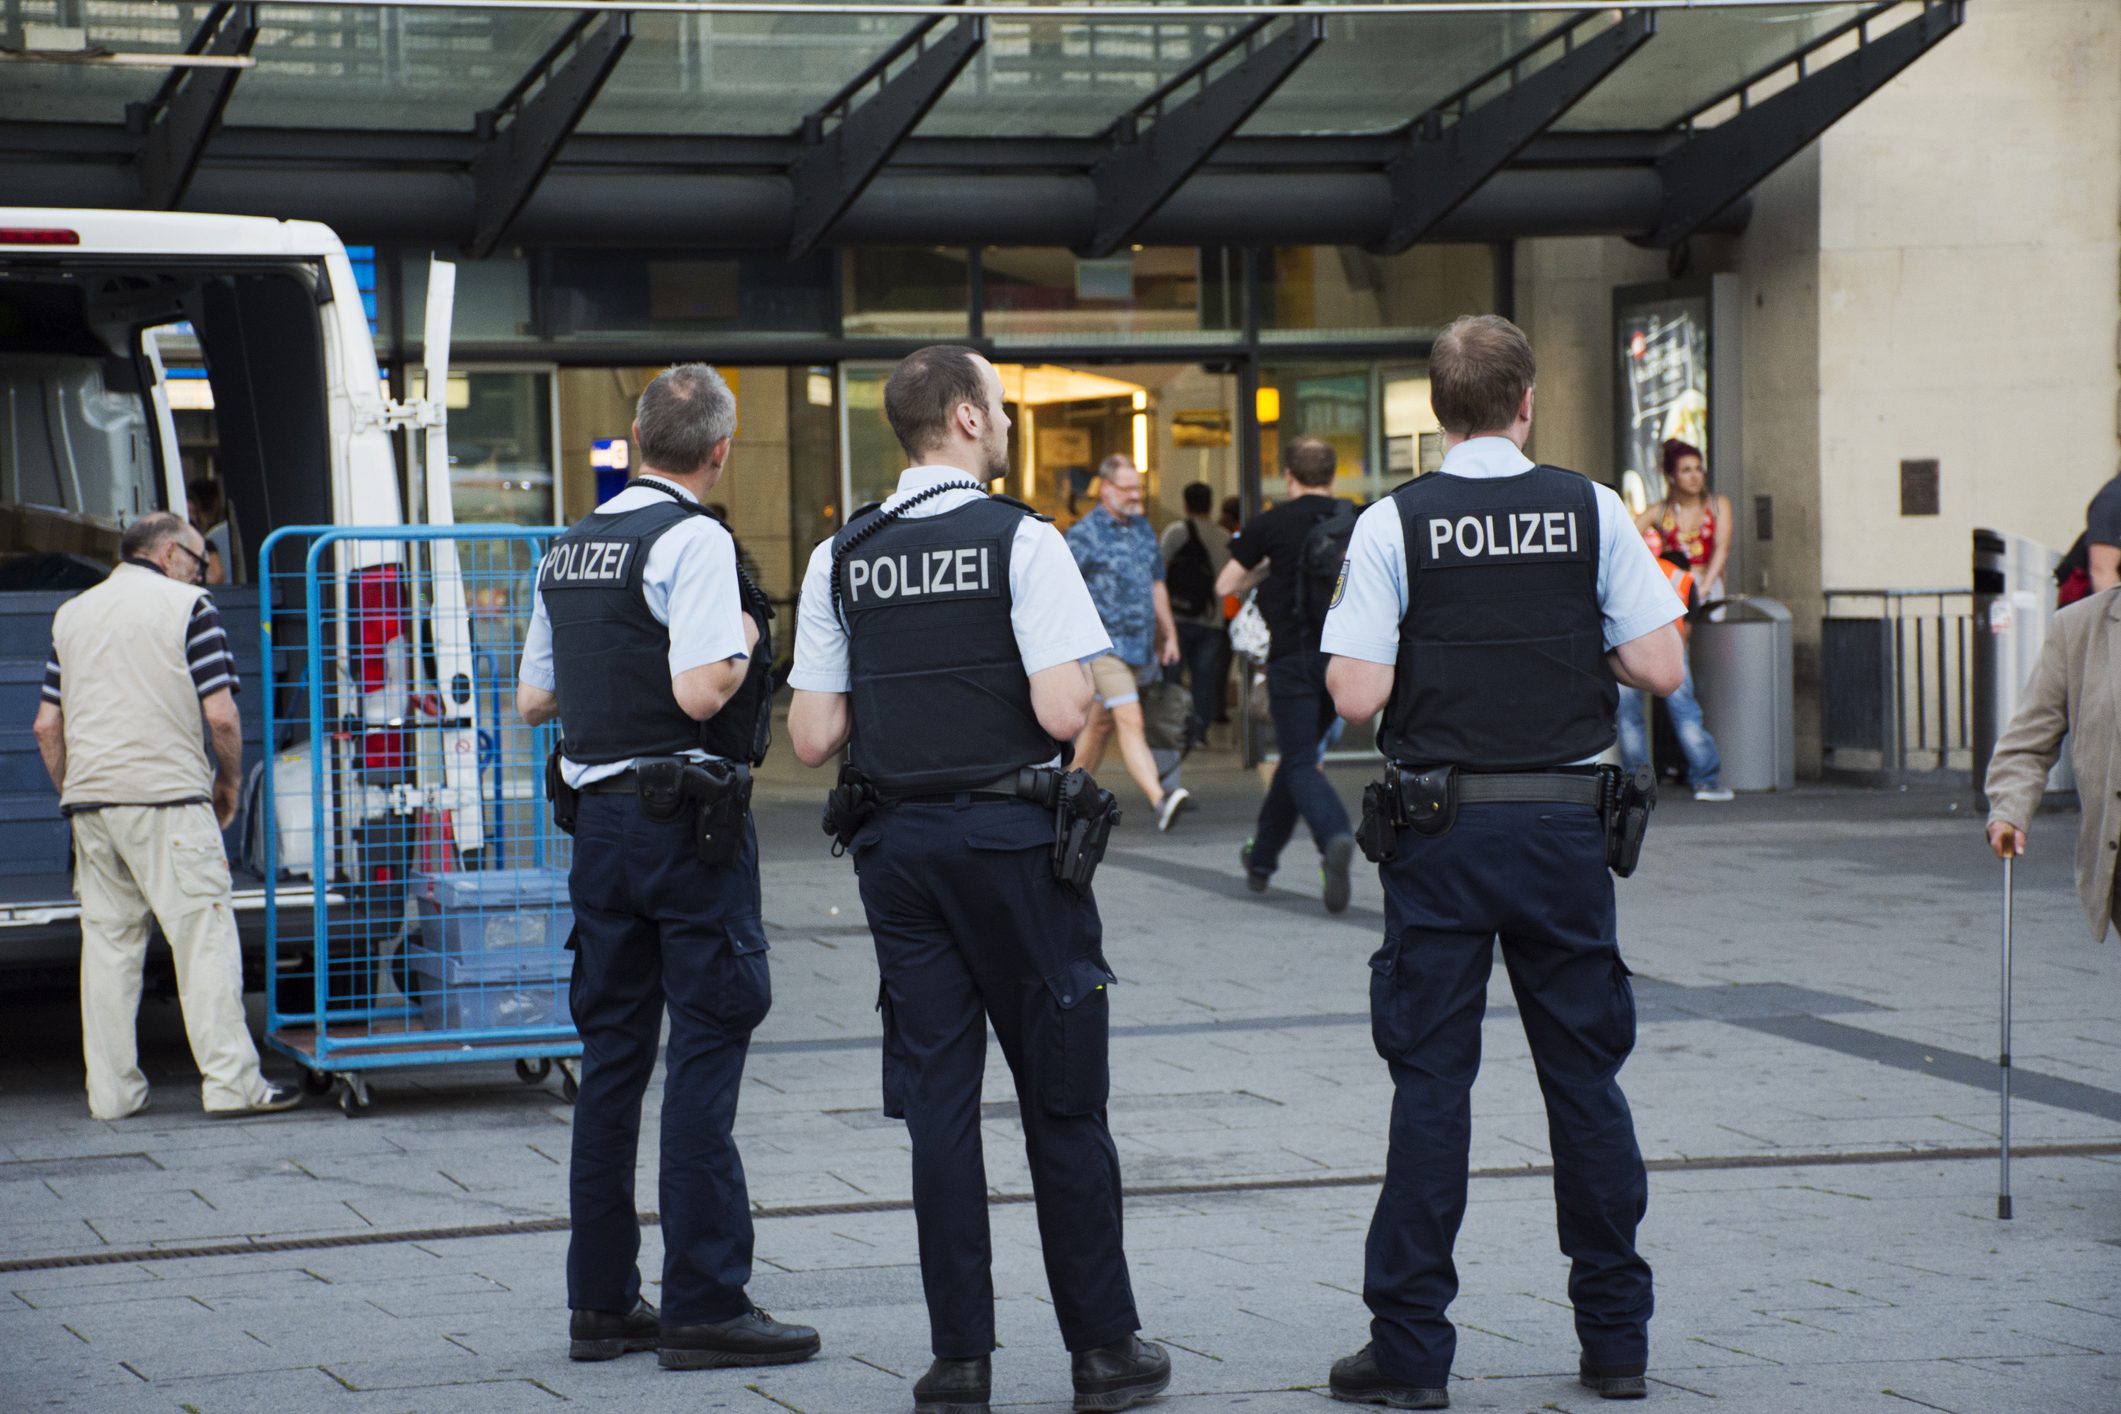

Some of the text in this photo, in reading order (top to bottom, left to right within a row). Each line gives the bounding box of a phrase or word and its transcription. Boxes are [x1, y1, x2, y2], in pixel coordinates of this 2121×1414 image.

[1429, 512, 1578, 560] POLIZEI
[541, 542, 630, 582] POLIZEI
[849, 548, 989, 602] POLIZEI
